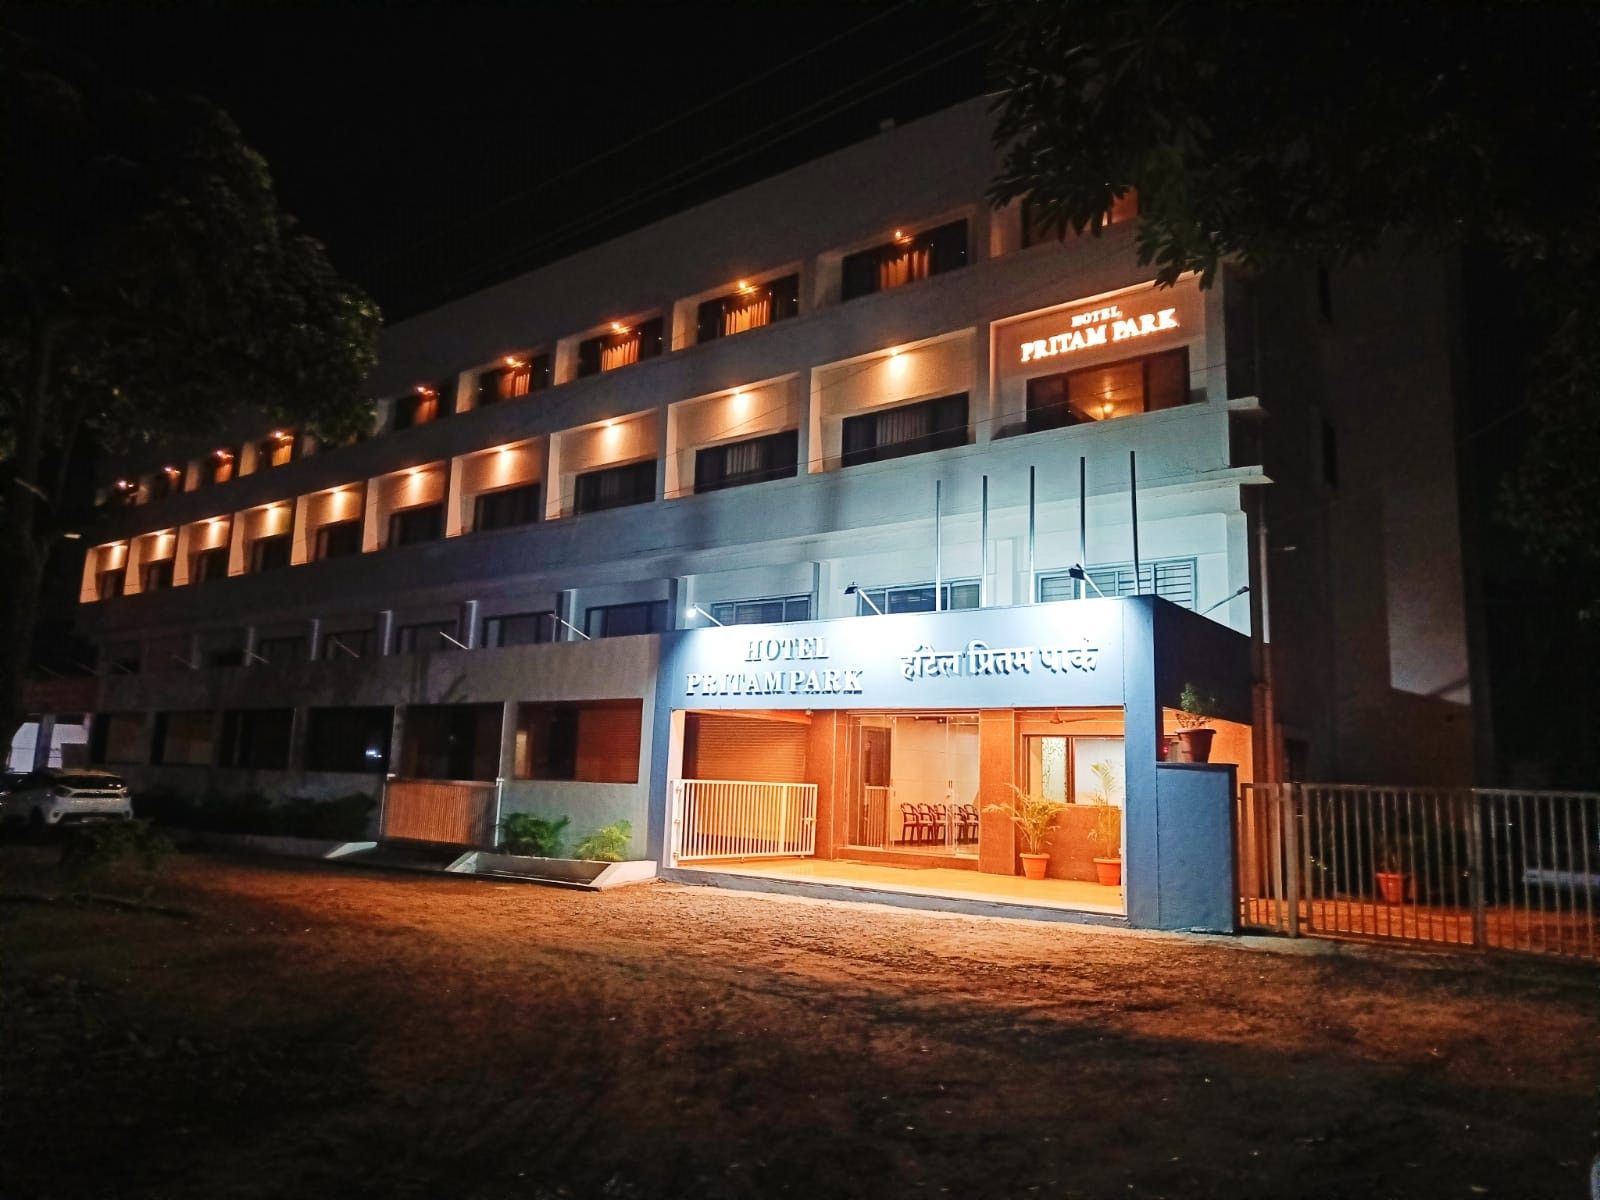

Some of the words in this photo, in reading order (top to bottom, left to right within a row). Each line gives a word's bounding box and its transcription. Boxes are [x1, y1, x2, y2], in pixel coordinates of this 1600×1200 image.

[1071, 305, 1121, 327] HOTEL
[1020, 324, 1107, 362] PRITAM
[1111, 308, 1179, 342] PARK
[744, 637, 829, 662] HOTEL
[1038, 637, 1099, 674] पार्क
[686, 671, 786, 696] PRITAM
[788, 669, 863, 695] PARK
